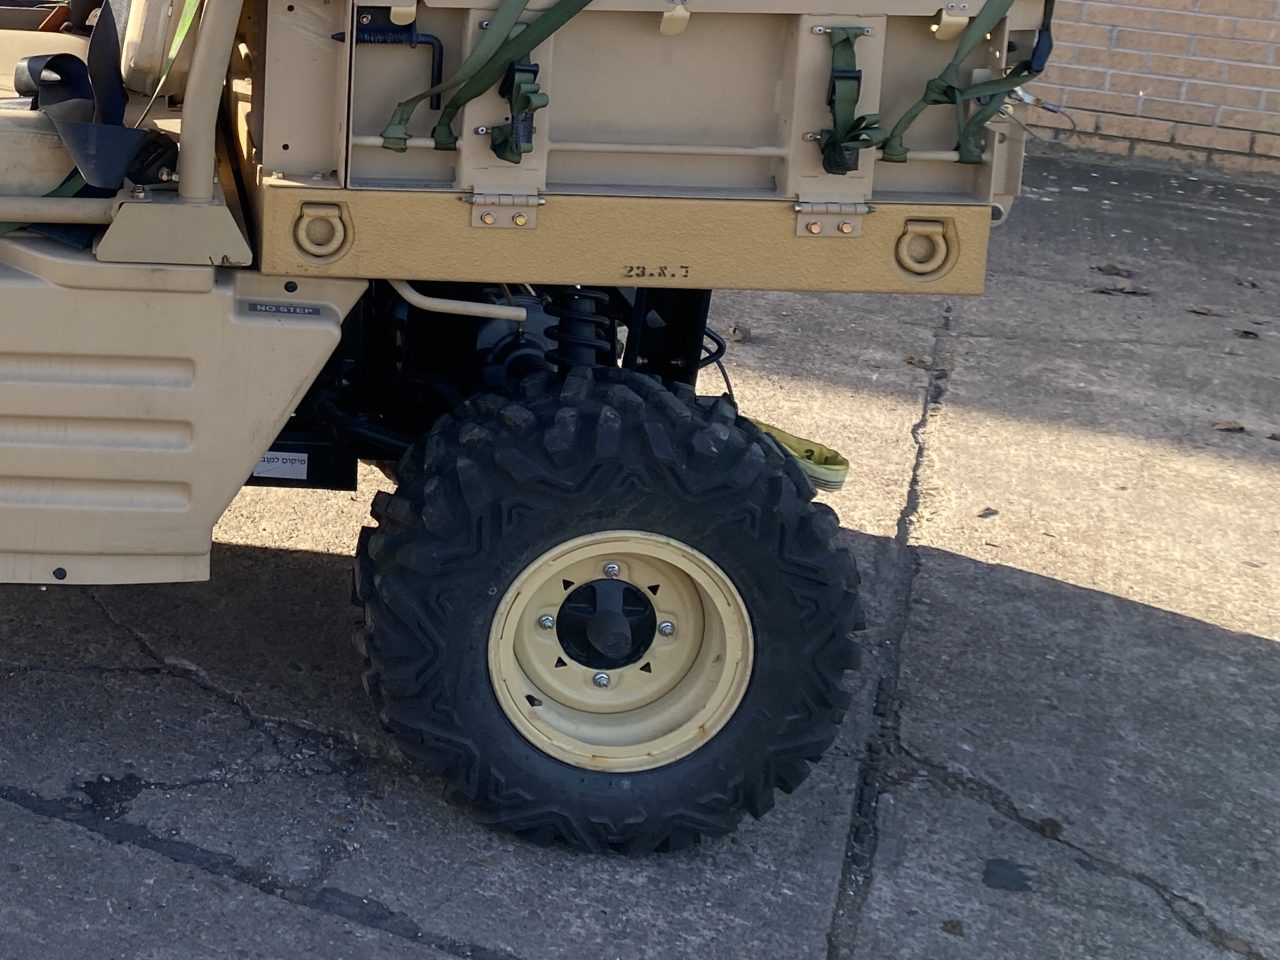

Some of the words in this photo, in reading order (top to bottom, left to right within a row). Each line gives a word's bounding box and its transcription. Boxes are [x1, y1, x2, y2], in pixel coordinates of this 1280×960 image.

[256, 304, 277, 313] NO
[279, 306, 314, 315] STEP
[282, 458, 306, 466] מיקום
